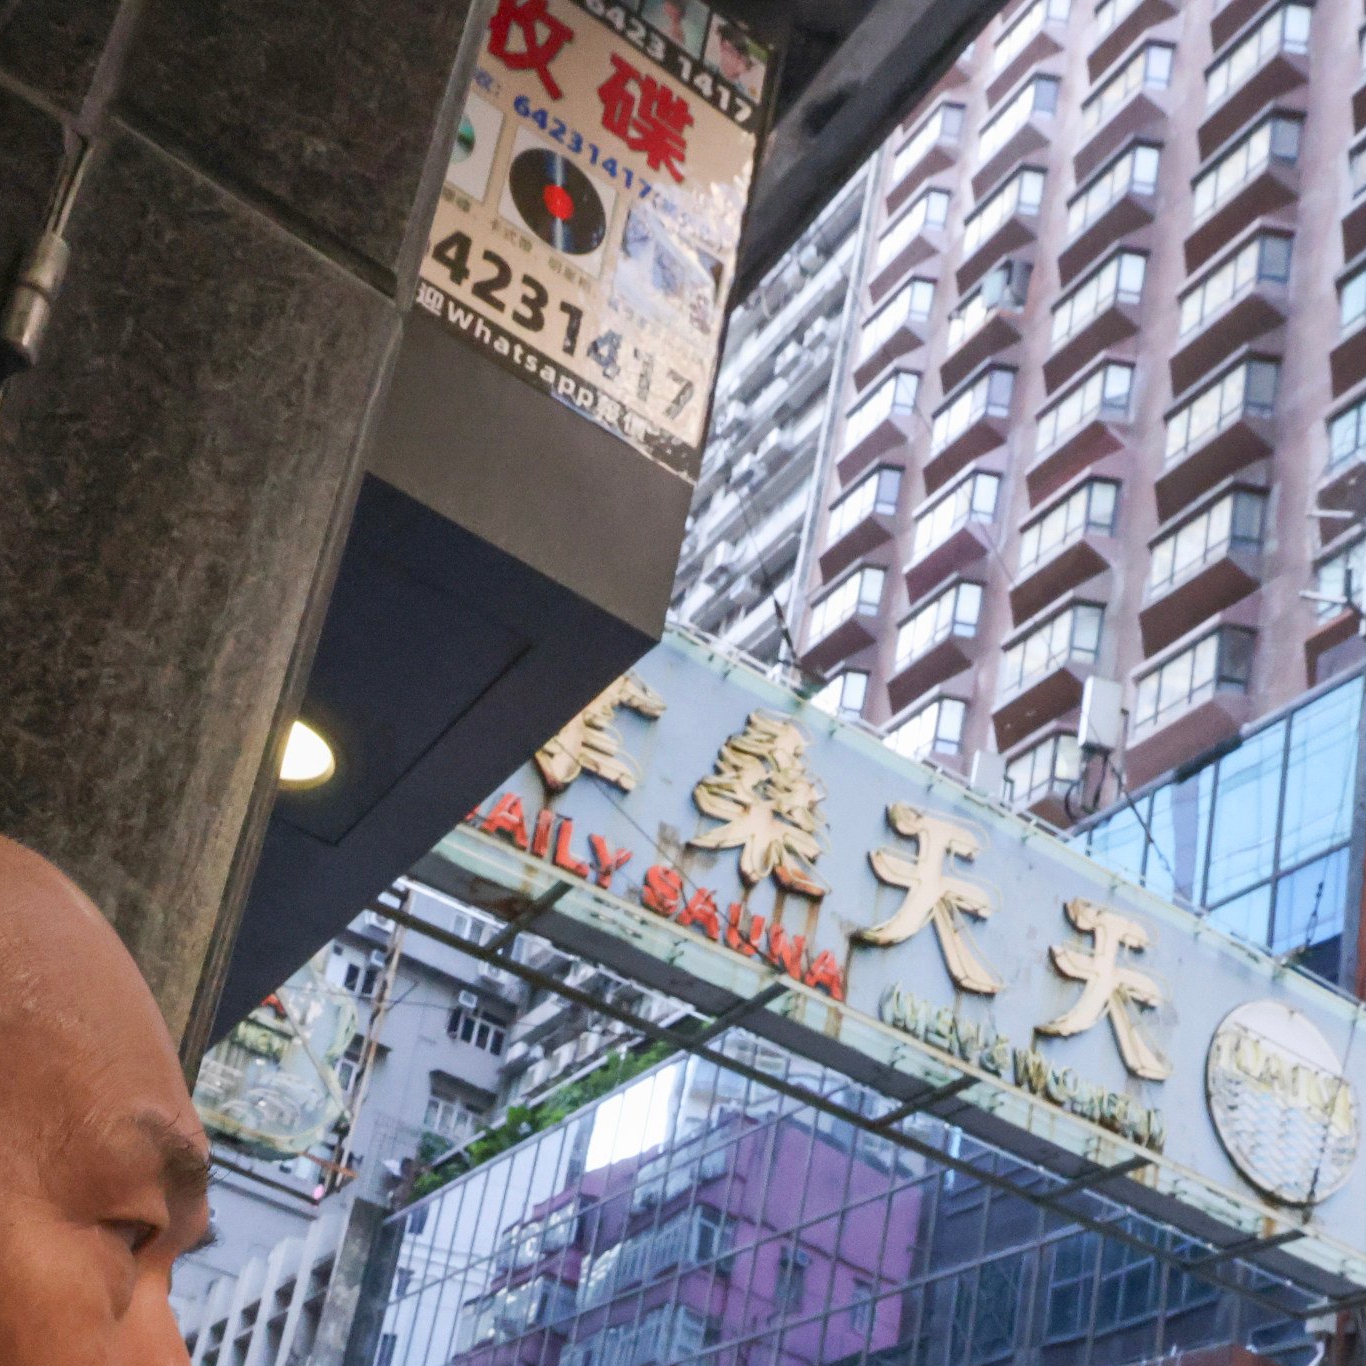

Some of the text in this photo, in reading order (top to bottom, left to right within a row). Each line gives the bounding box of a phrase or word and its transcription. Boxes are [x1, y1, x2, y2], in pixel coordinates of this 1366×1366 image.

[677, 55, 753, 123] 1417
[513, 95, 653, 199] 64231417
[463, 792, 846, 1001] AILY SAUNA
